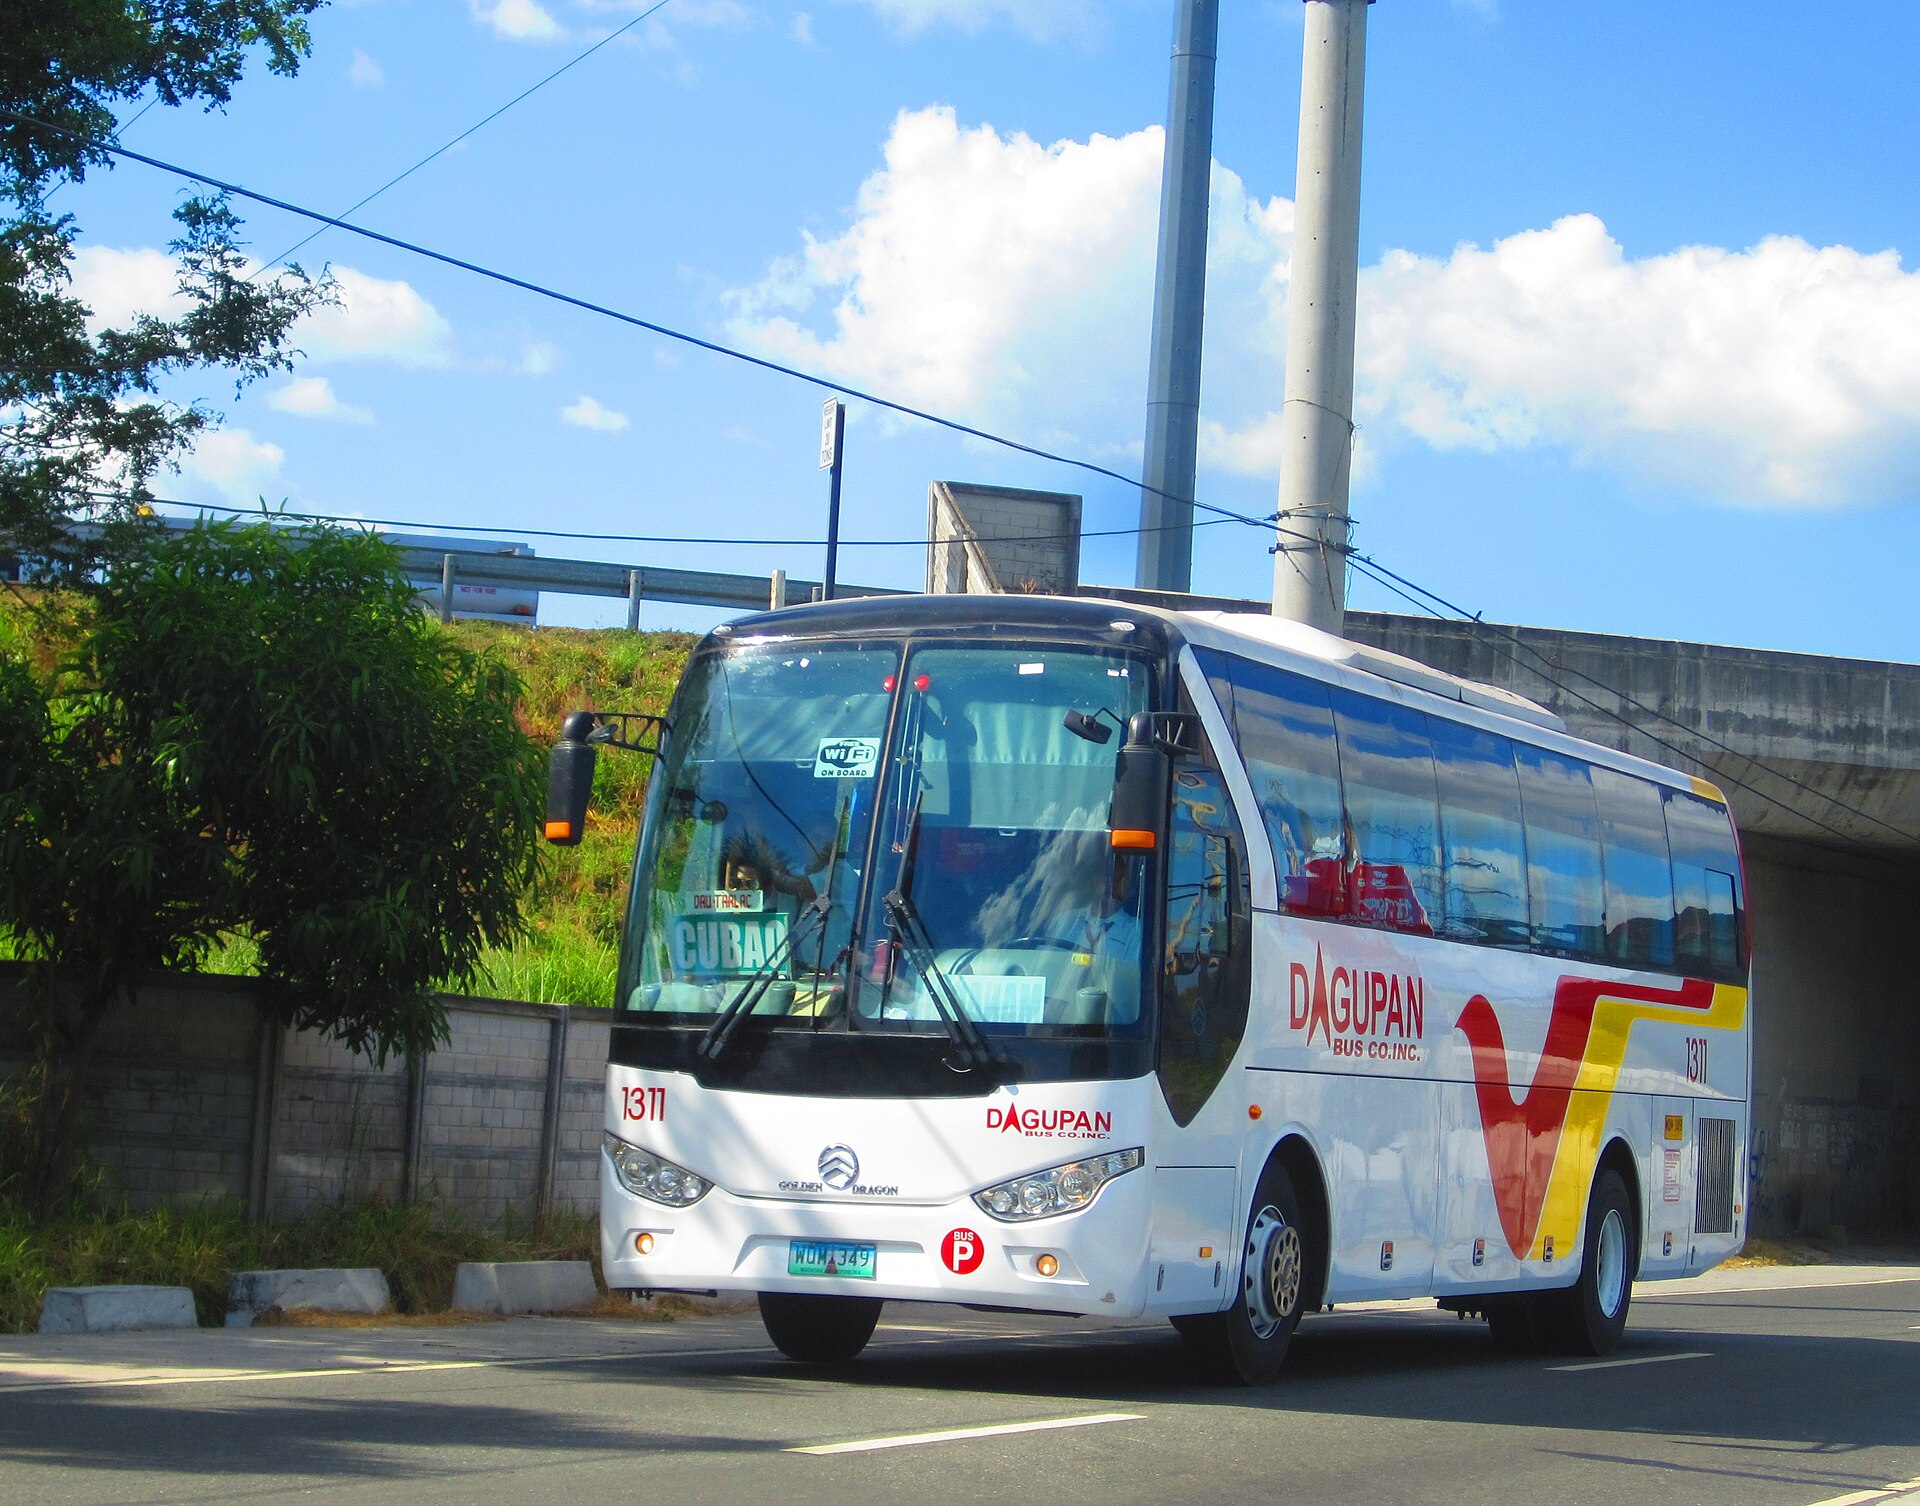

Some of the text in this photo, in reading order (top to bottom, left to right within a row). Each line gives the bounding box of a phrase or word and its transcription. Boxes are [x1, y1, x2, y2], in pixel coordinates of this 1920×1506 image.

[675, 919, 786, 970] CUBAO
[1289, 939, 1423, 1049] DAGUPAN
[1333, 1038, 1364, 1057] BUS
[1685, 1037, 1708, 1084] 1311
[621, 1086, 666, 1122] 1311
[986, 1101, 1112, 1134] DAGUPAN
[778, 1180, 899, 1196] GOLDEN DRAGON
[953, 1231, 974, 1241] BUS
[837, 1248, 869, 1267] 349
[953, 1240, 974, 1271] P
